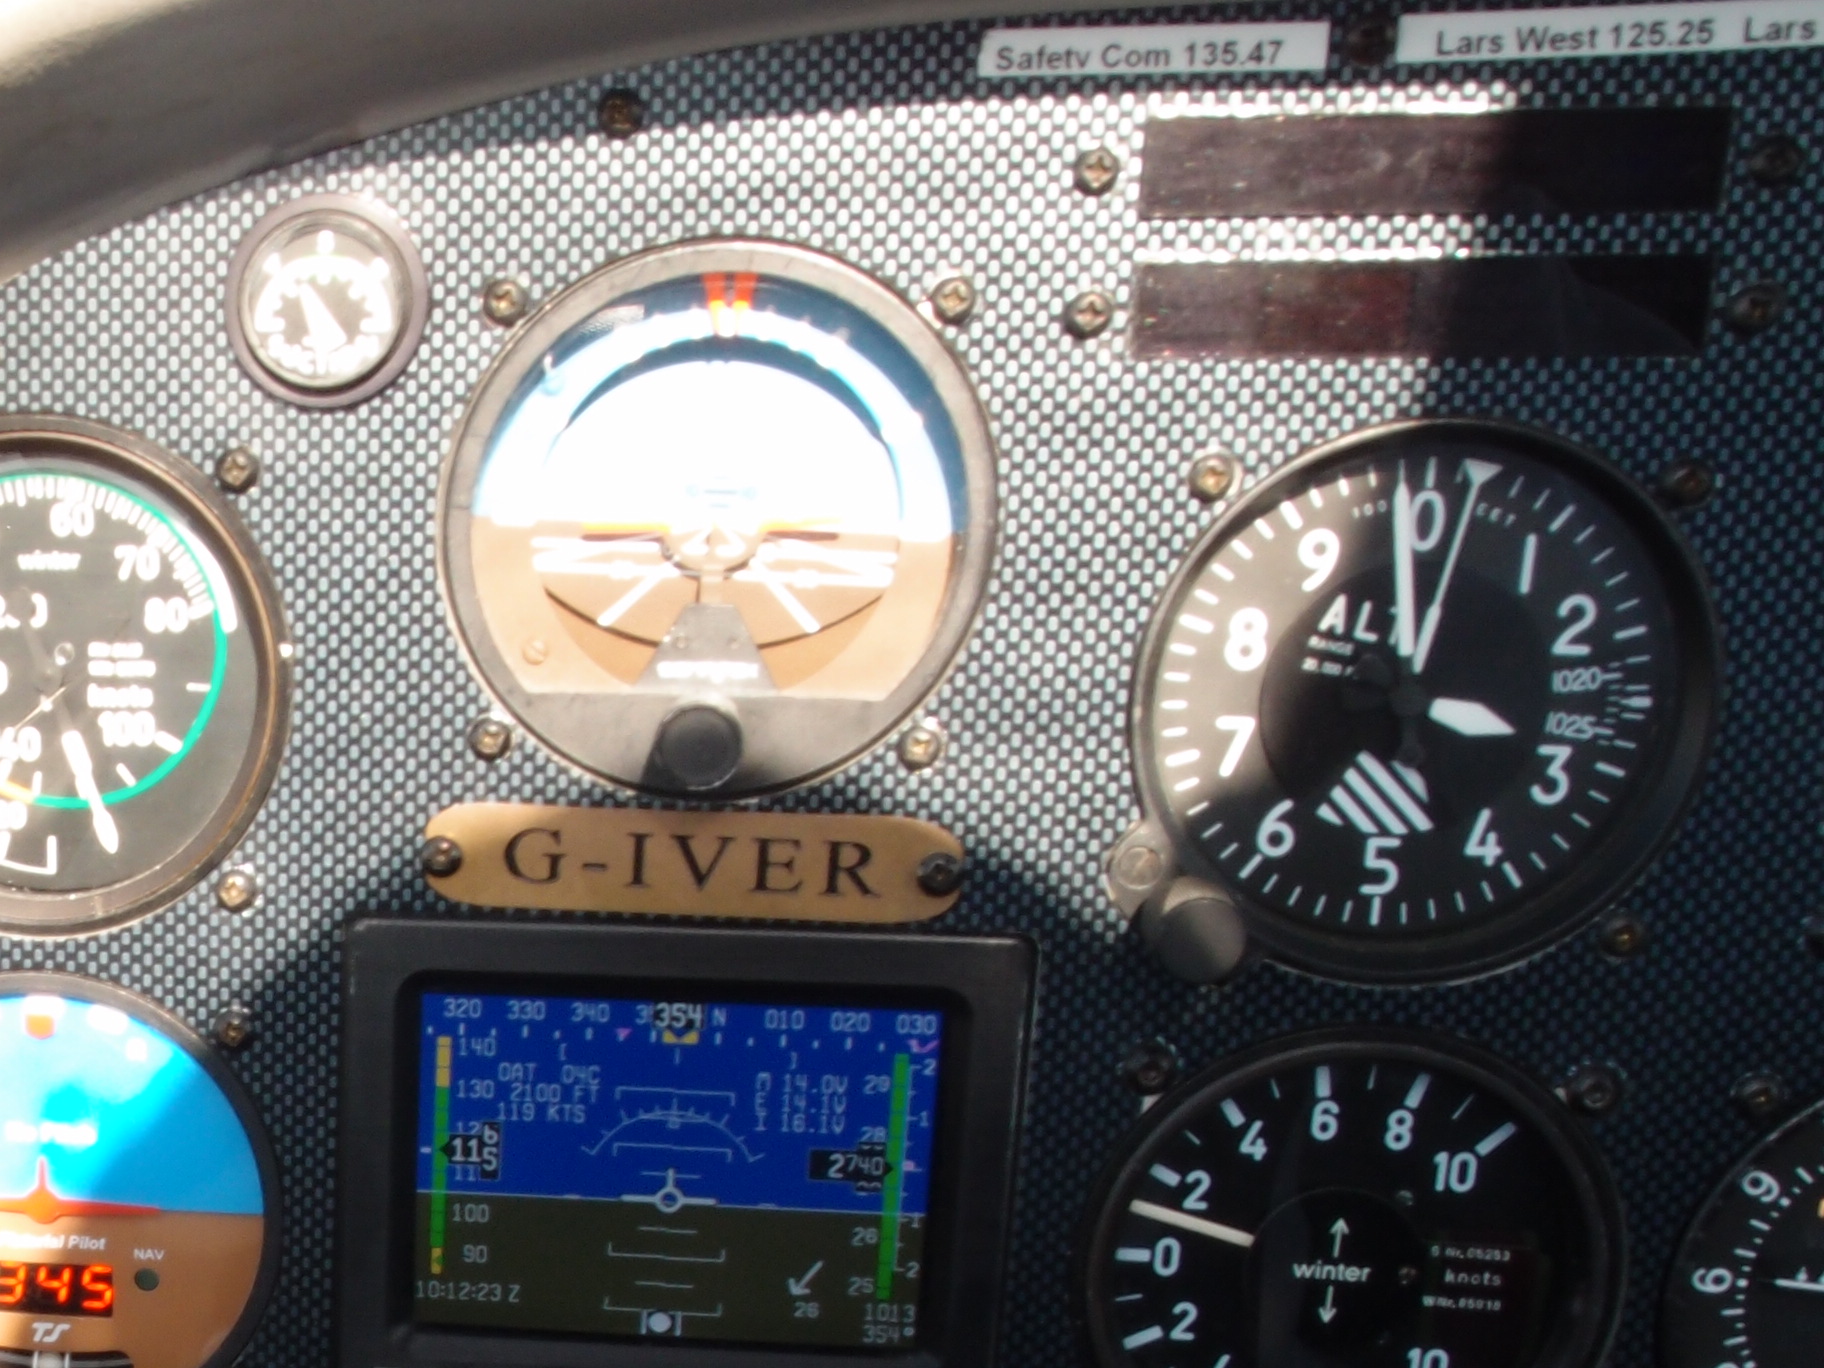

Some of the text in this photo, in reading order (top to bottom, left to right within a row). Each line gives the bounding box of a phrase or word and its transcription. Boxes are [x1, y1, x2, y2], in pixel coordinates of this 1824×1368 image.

[1101, 43, 1172, 69] Com
[1184, 39, 1284, 67] 135.47
[1436, 16, 1817, 56] Lars West 125.25 Lars
[50, 499, 94, 537] 60
[114, 544, 160, 581] 70
[1297, 527, 1341, 593] 9
[1519, 532, 1538, 595] 1
[144, 596, 189, 633] 80
[1550, 593, 1598, 657] 2
[1222, 606, 1269, 673] 8
[1551, 666, 1603, 694] 1020
[98, 710, 155, 747] 100
[1544, 711, 1598, 740] 1025
[1214, 714, 1257, 778] 7
[1530, 744, 1572, 805] 3
[1256, 799, 1296, 858] 6
[1464, 808, 1504, 867] 4
[503, 826, 881, 900] G-IVER
[1360, 837, 1401, 896] 5
[442, 997, 483, 1020] 320
[506, 999, 547, 1021] 330
[570, 1001, 611, 1023] 340
[653, 1001, 704, 1029] 354
[763, 1008, 806, 1031] 010
[829, 1010, 872, 1033] 020
[894, 1012, 938, 1036] 030
[458, 1037, 497, 1058] 140
[456, 1079, 496, 1100] 130
[497, 1061, 537, 1083] OAT
[545, 1103, 587, 1124] KTS
[1309, 1099, 1341, 1142] 6
[1383, 1107, 1416, 1152] 8
[1238, 1119, 1269, 1162] 4
[1180, 1168, 1213, 1212] 2
[1431, 1150, 1478, 1194] 10
[452, 1203, 490, 1224] 100
[67, 1234, 107, 1251] Pilot
[133, 1248, 165, 1261] NAV
[462, 1244, 489, 1264] 90
[1151, 1235, 1183, 1278] 0
[1290, 1259, 1373, 1284] winter
[1443, 1267, 1503, 1287] knots
[415, 1280, 503, 1302] 10:12:23
[862, 1303, 917, 1324] 1013
[1169, 1300, 1199, 1342] 2
